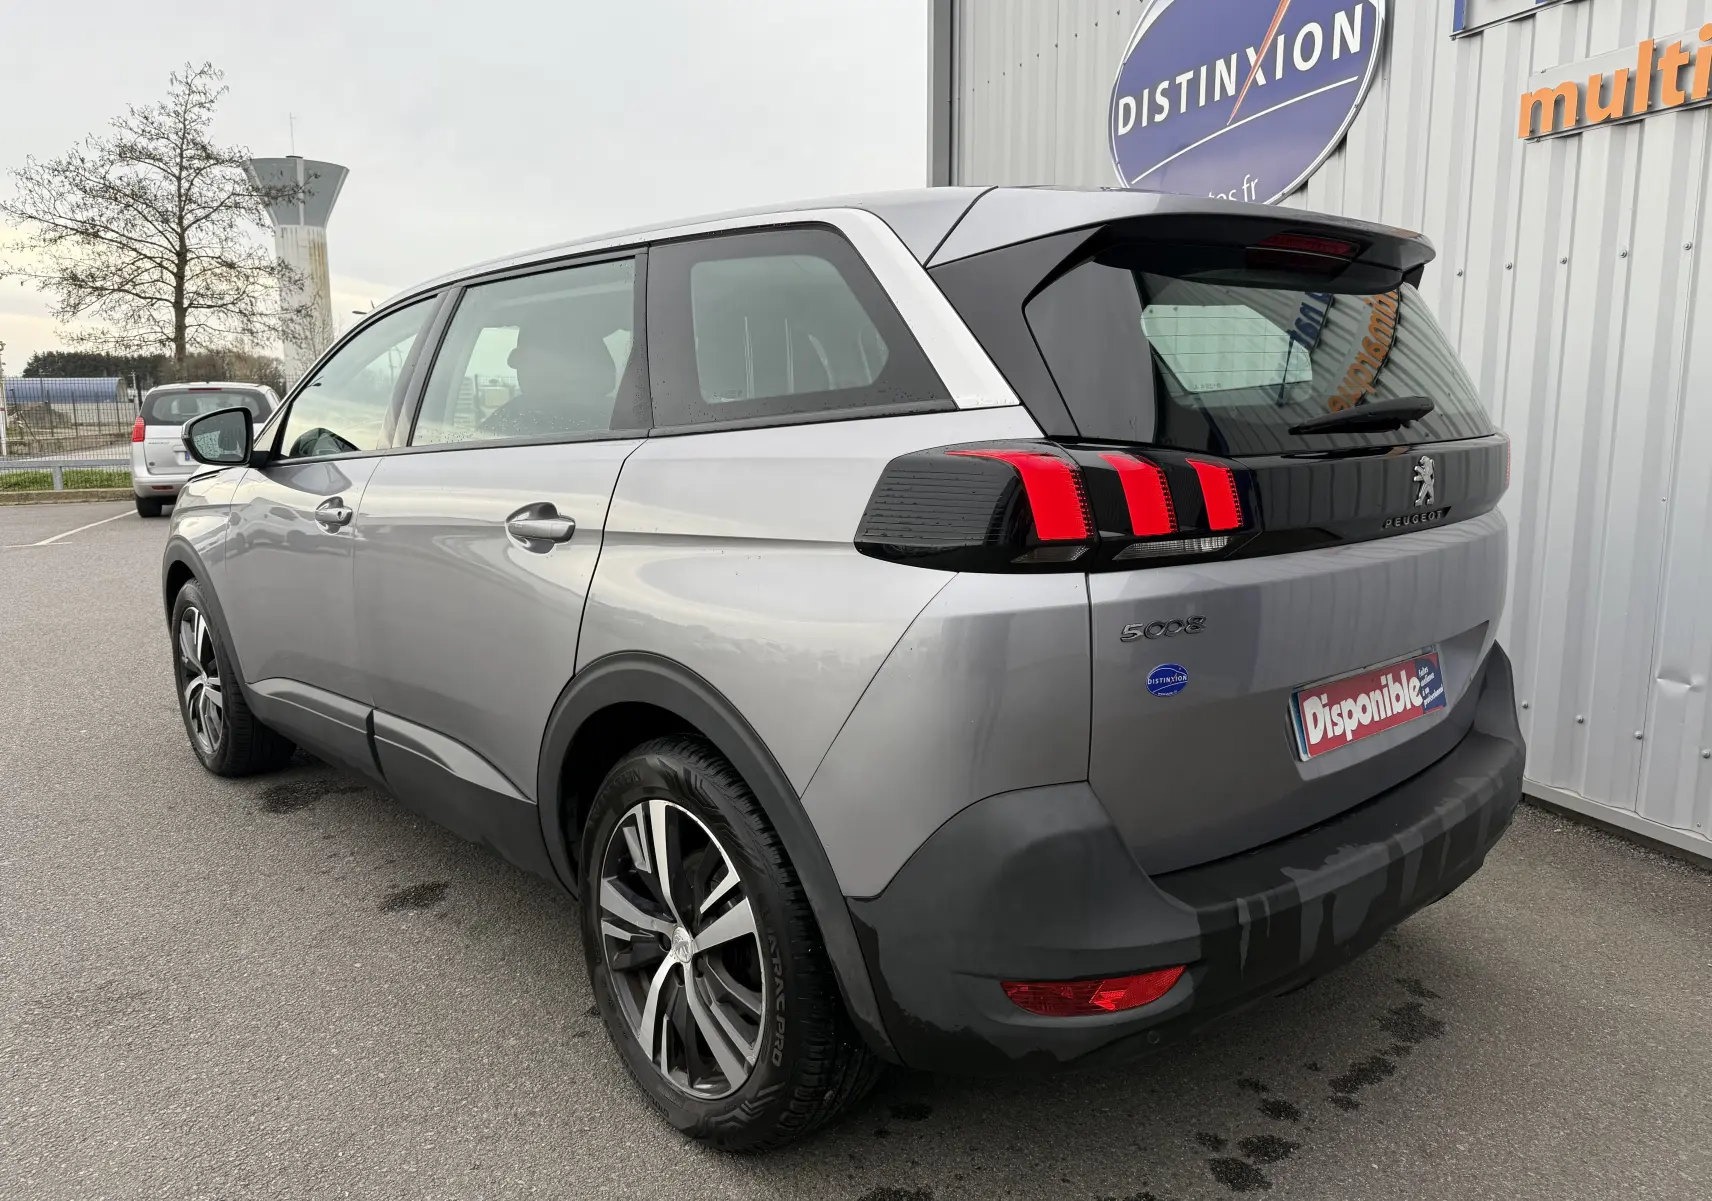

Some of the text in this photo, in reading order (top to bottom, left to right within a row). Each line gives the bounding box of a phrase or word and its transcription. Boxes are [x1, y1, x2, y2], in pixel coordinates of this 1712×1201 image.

[1118, 3, 1363, 136] DISTINXION
[1384, 511, 1442, 529] PEUGEOT
[1120, 615, 1206, 643] 5008
[1147, 673, 1187, 685] DISTINXION
[1303, 669, 1423, 745] Disponible
